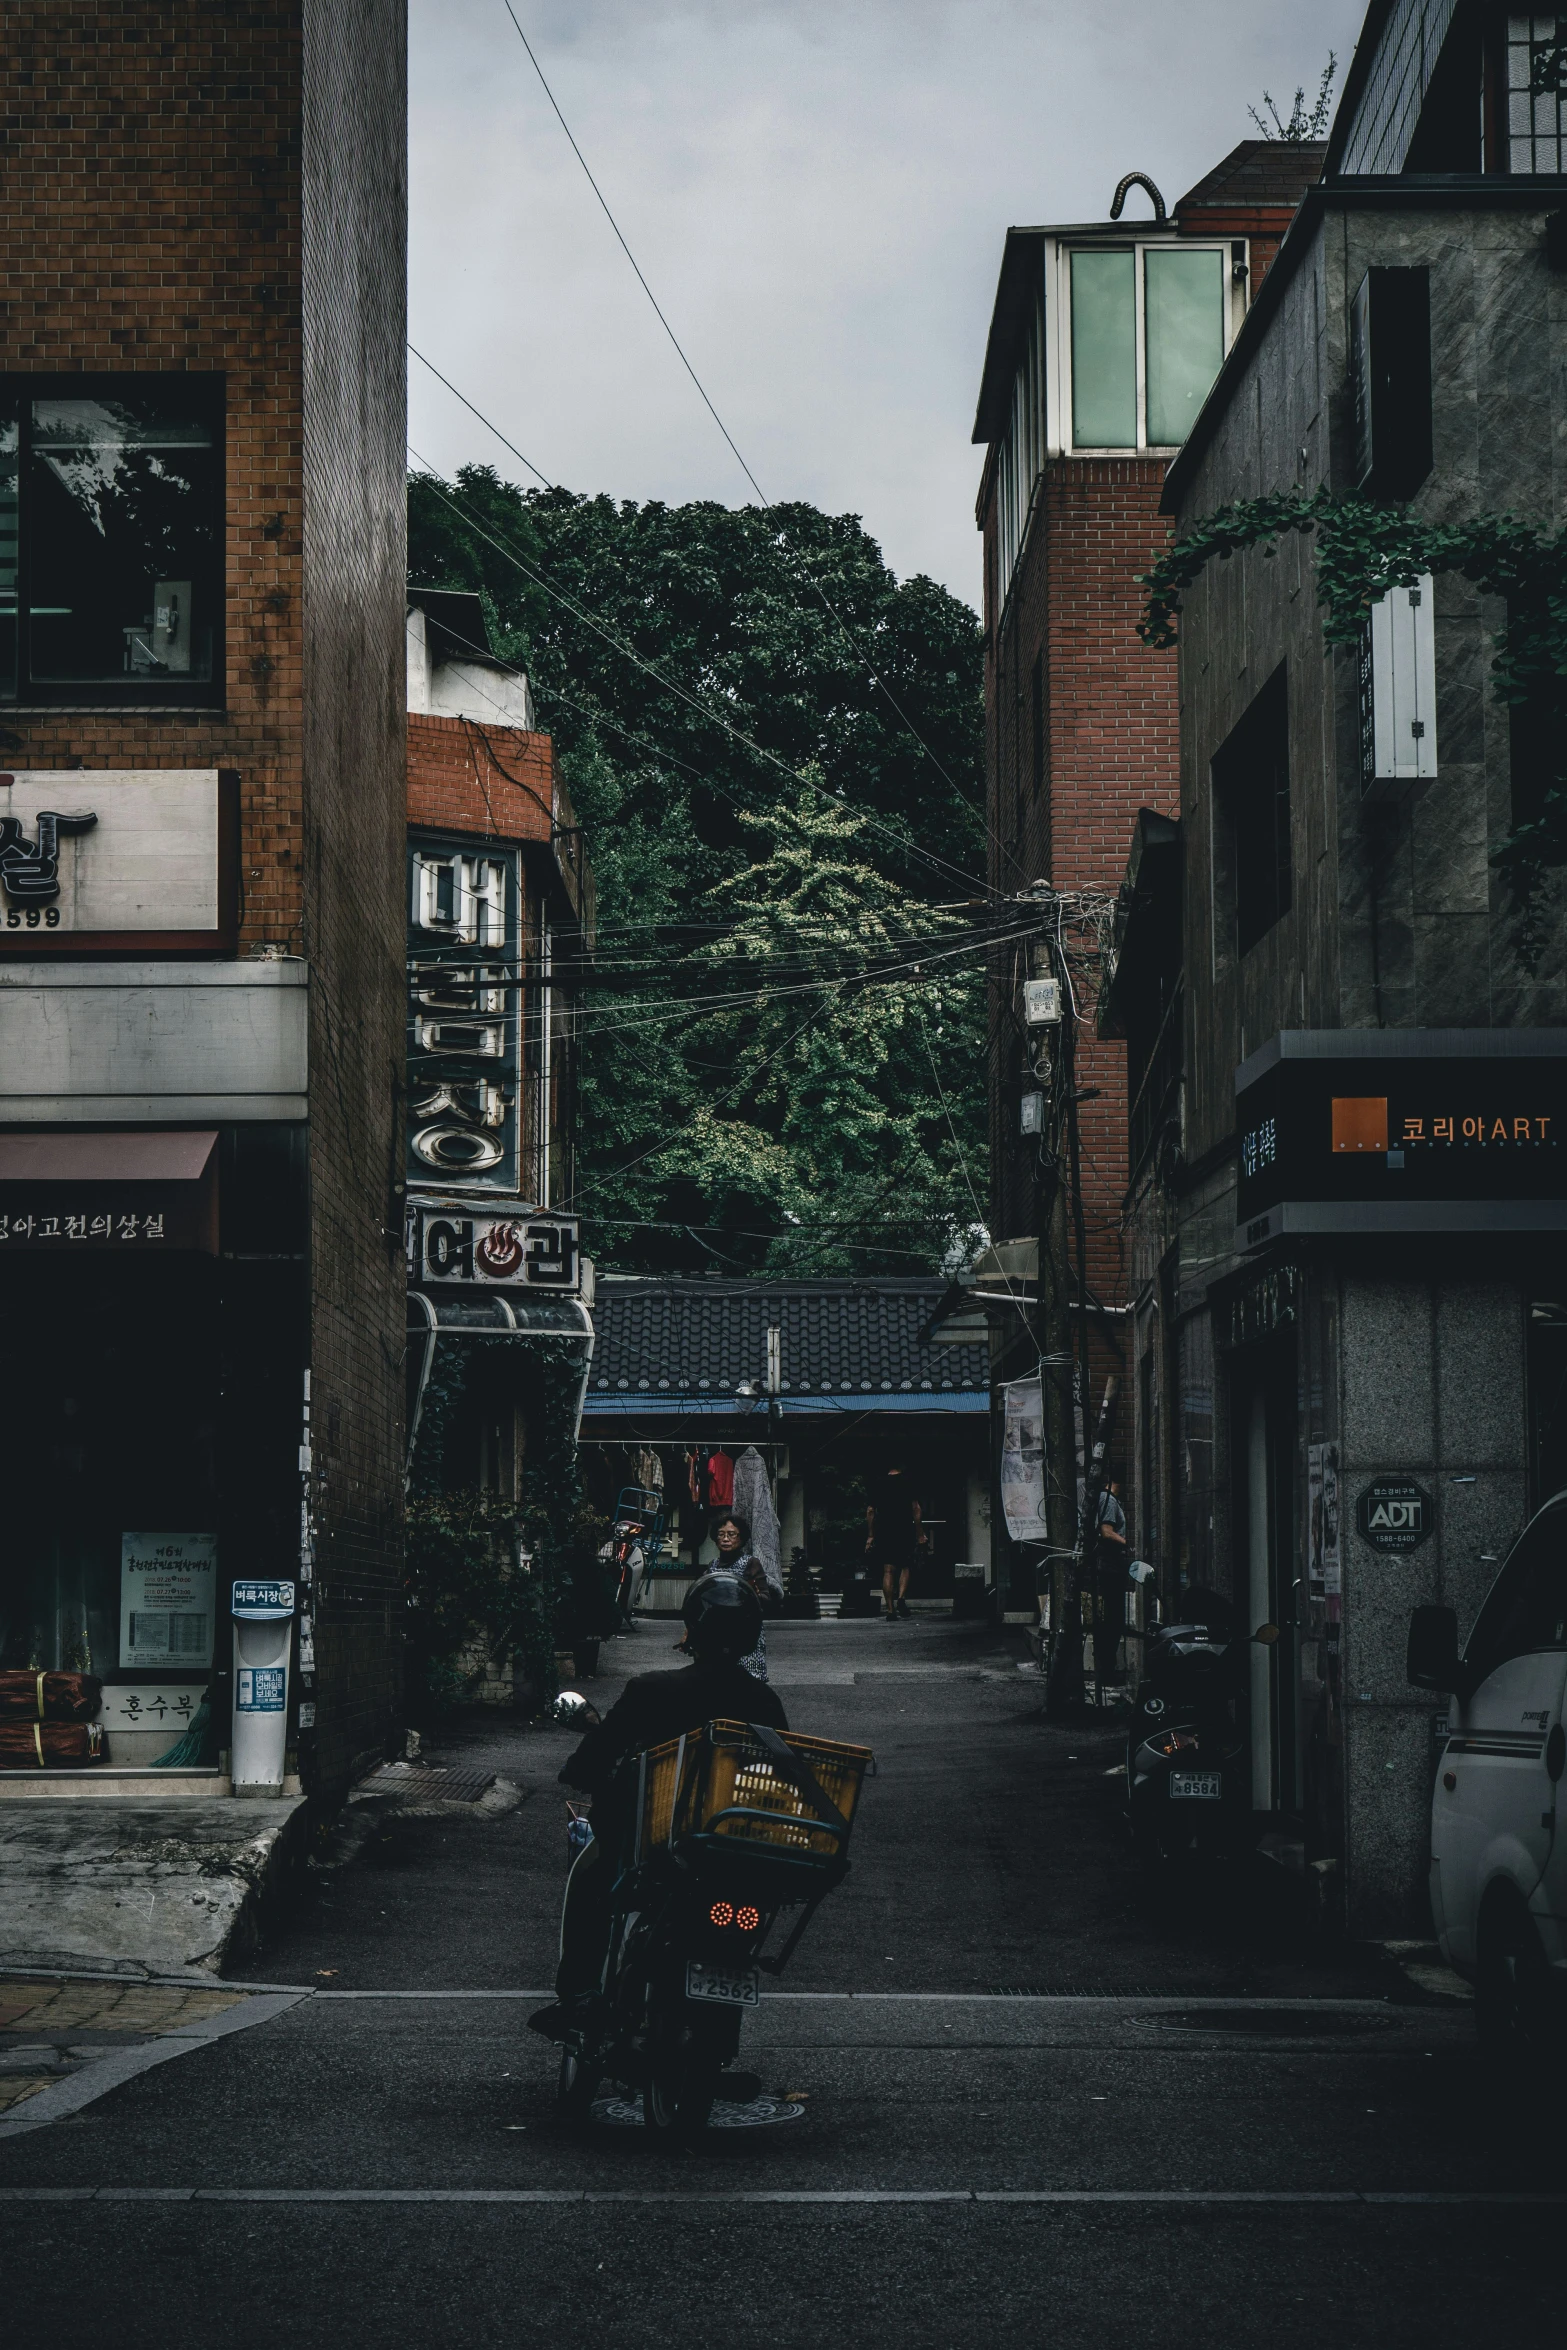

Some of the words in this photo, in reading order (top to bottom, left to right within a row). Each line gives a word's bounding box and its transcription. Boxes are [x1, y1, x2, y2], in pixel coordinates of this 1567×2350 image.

[0, 907, 60, 928] 599
[411, 851, 514, 1171] 대림장
[1368, 1501, 1421, 1528] ADT
[235, 1590, 279, 1603] 벼룩시장
[255, 1690, 278, 1698] 보세요
[1184, 1782, 1217, 1795] 8584
[707, 1979, 754, 2001] 2562
